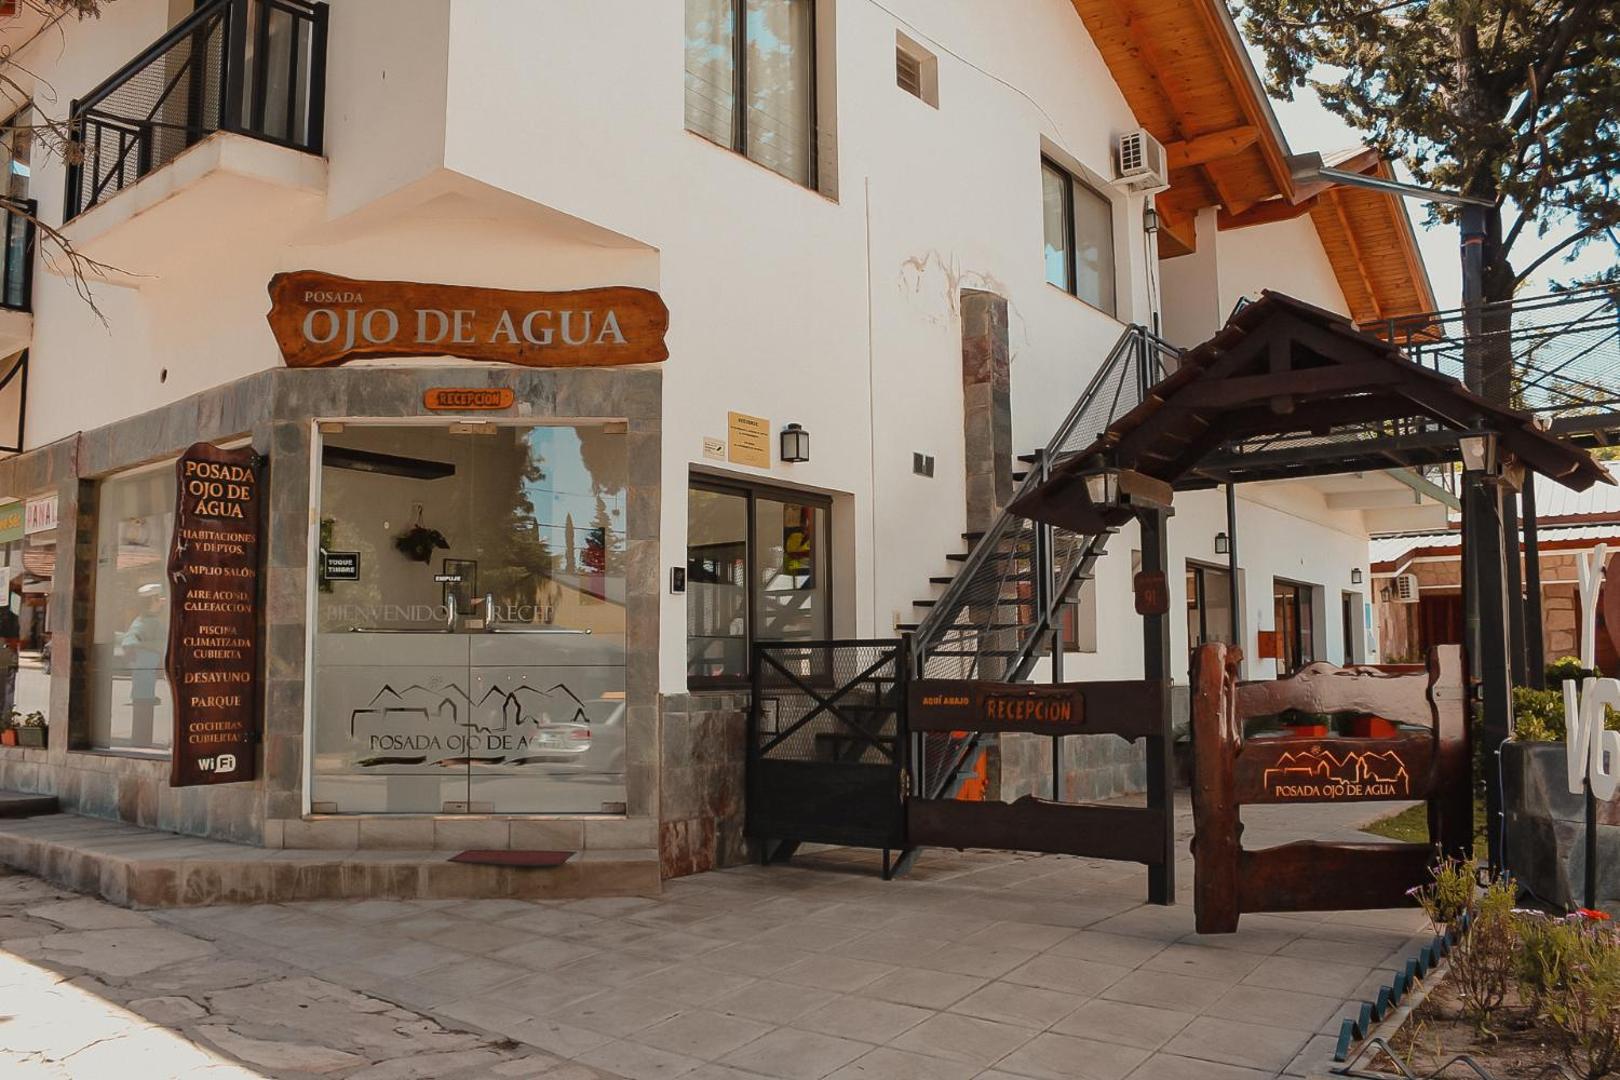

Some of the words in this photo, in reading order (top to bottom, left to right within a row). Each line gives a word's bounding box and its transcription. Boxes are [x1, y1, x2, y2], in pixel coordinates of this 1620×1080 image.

[304, 291, 364, 303] POSADA
[302, 308, 399, 351] OJO
[415, 308, 476, 344] DE
[489, 309, 628, 345] AGUA
[185, 461, 254, 484] POSADA
[189, 480, 223, 500] OJO
[227, 485, 250, 500] DE
[194, 500, 244, 518] AGUA
[183, 529, 256, 543] HABITACIONES
[195, 542, 202, 551] Y
[328, 566, 355, 574] TIMBRE
[186, 590, 212, 599] AIRE
[327, 605, 455, 622] BIENVENIDO
[199, 625, 238, 636] PISCINA
[183, 637, 252, 649] CLIMATIZADA
[193, 649, 241, 660] CUBIERTA
[184, 671, 251, 684] DESAYUNO
[191, 695, 241, 709] PARQUE
[189, 721, 243, 732] COCHERAS
[189, 733, 241, 744] CUBIERTA
[370, 735, 441, 751] POSADA
[447, 735, 481, 753] OJO
[487, 735, 512, 751] DE
[1275, 785, 1320, 797] POSADA
[1322, 785, 1344, 798] OJO
[1346, 784, 1362, 796] DE
[1365, 784, 1396, 796] AGUA
